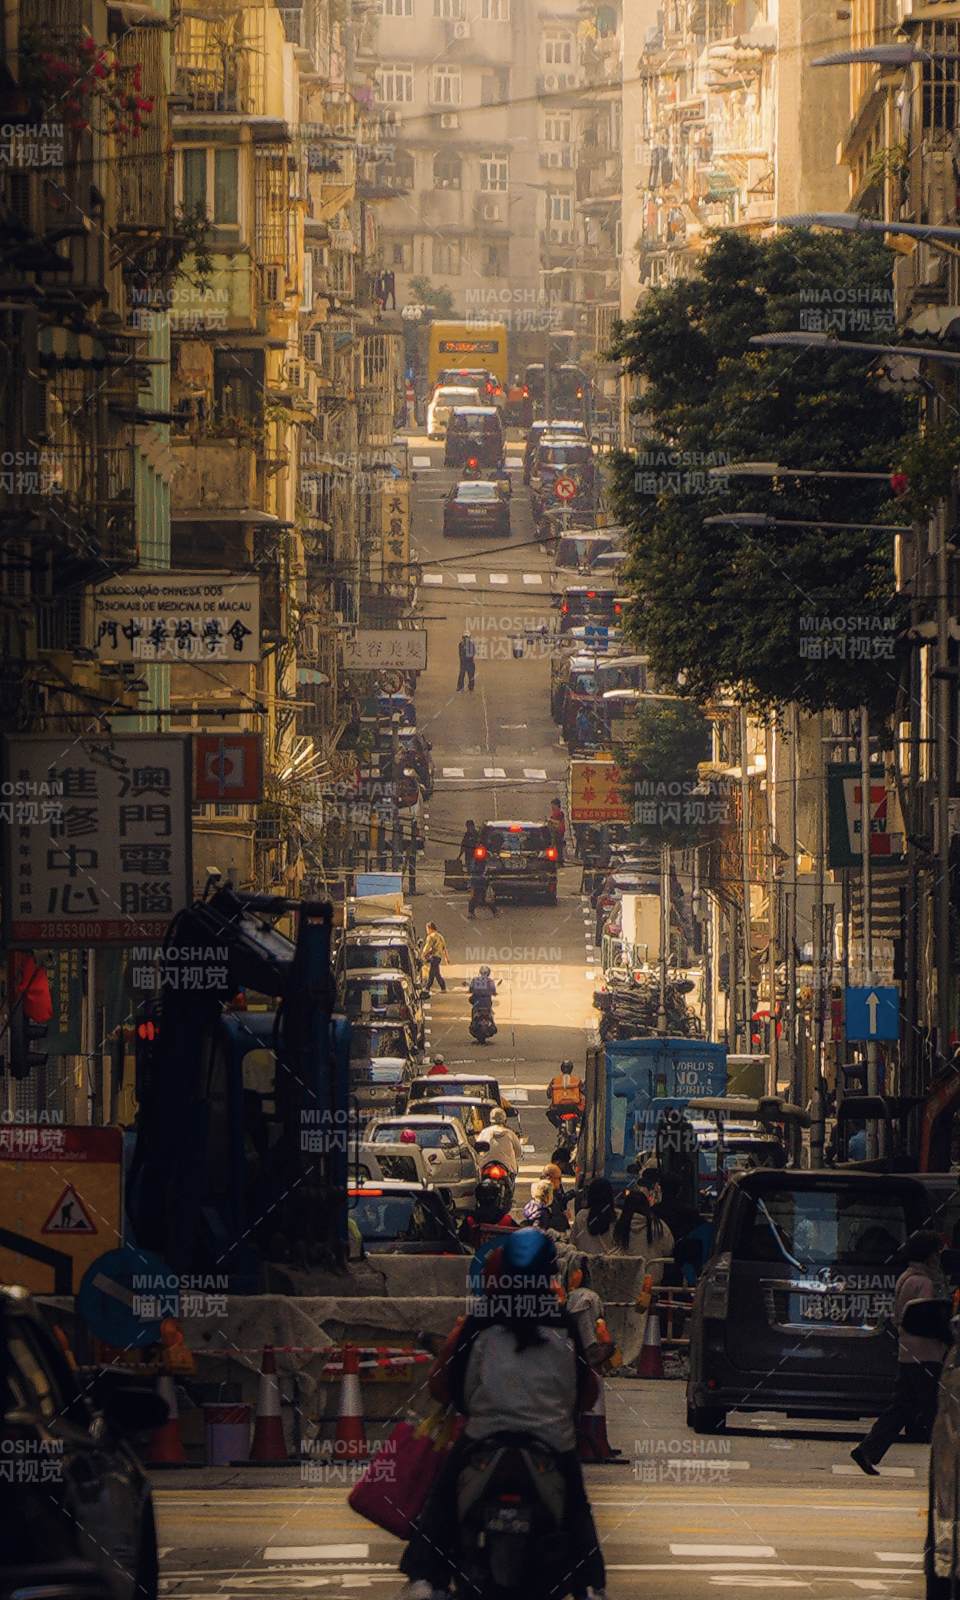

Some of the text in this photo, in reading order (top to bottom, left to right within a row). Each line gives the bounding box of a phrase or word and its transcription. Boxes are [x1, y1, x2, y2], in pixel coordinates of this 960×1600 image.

[162, 585, 201, 595] CHINESA
[204, 585, 223, 595] DOS
[143, 602, 155, 611] DE
[157, 602, 200, 611] MEDICINA
[204, 602, 215, 611] DE
[218, 602, 251, 611] MACAU
[118, 766, 172, 914] 澳門電腦
